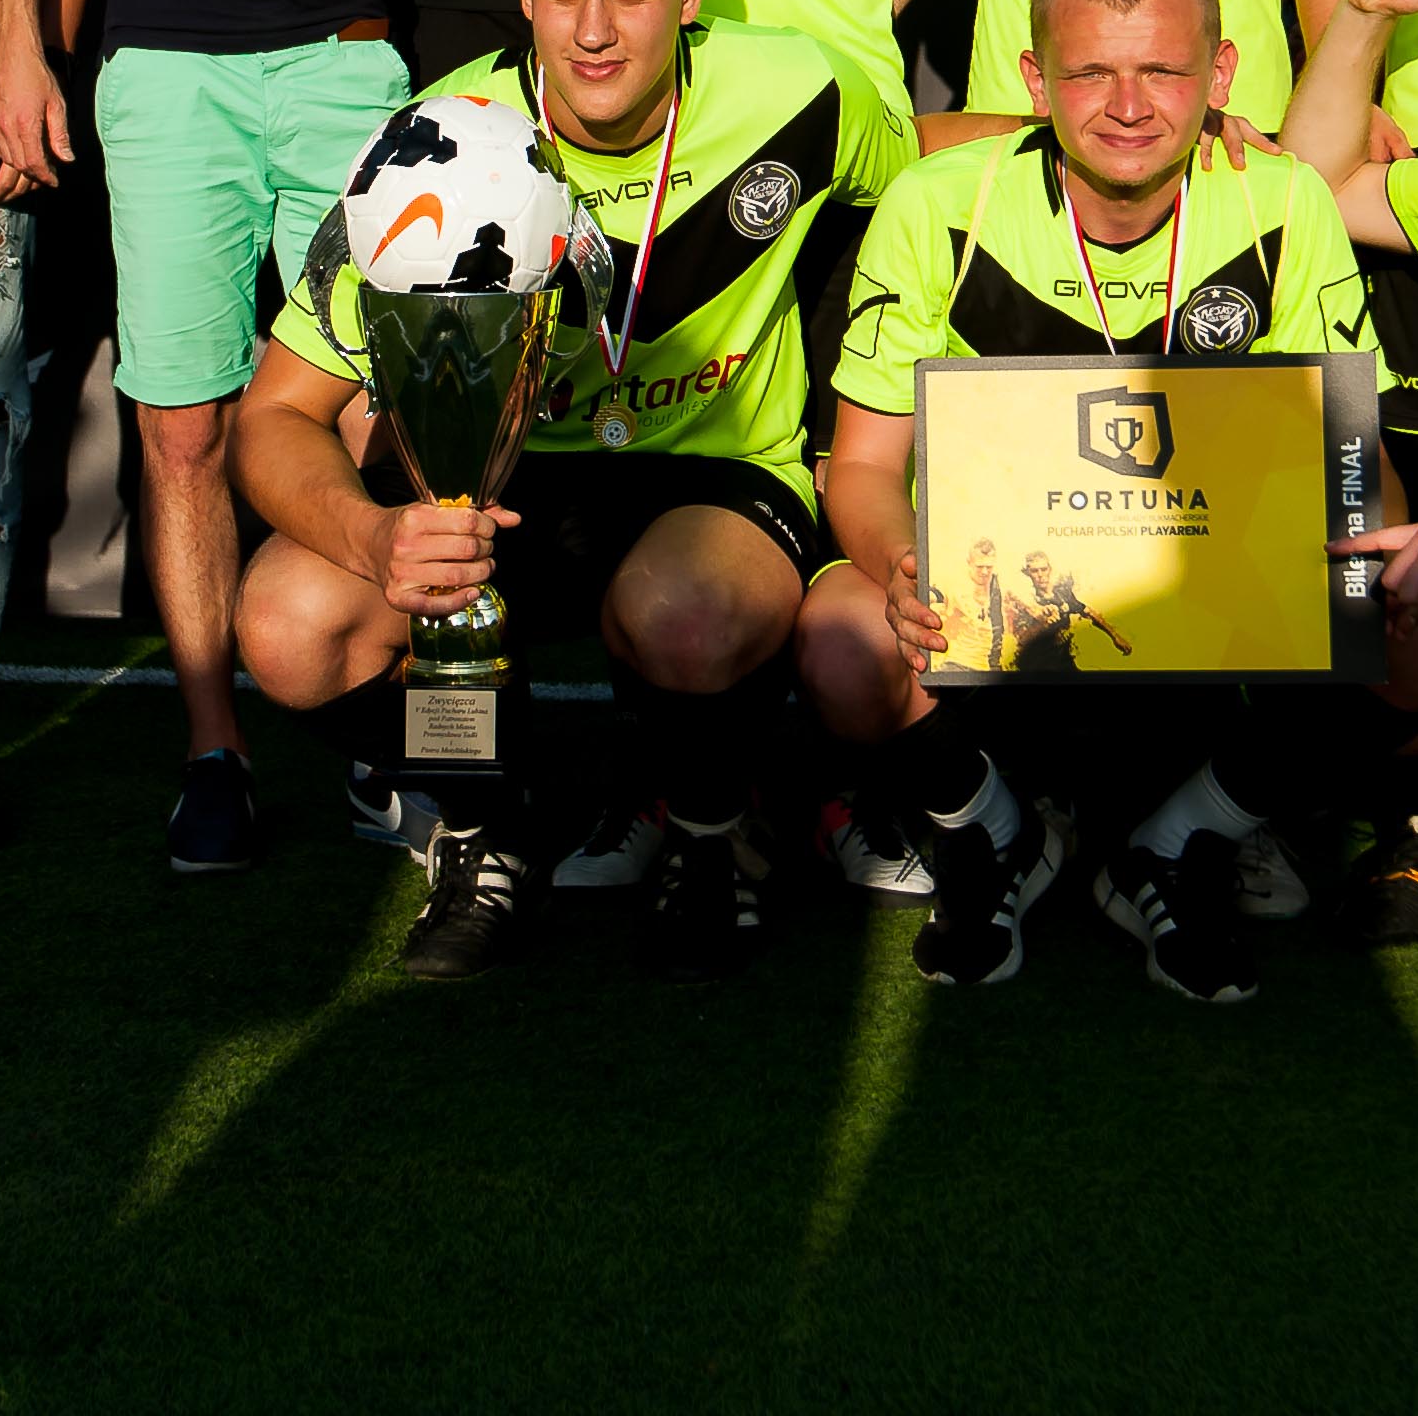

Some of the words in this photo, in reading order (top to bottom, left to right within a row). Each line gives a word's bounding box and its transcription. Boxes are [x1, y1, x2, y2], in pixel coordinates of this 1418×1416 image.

[575, 170, 693, 210] GIVOA
[1340, 437, 1364, 507] FINAŁ
[1047, 488, 1209, 511] FORTUNA
[1047, 526, 1094, 537] PUCHAR
[1097, 526, 1138, 537] POLSKI
[1141, 525, 1210, 536] PLAYARENA
[1342, 551, 1368, 598] Bile
